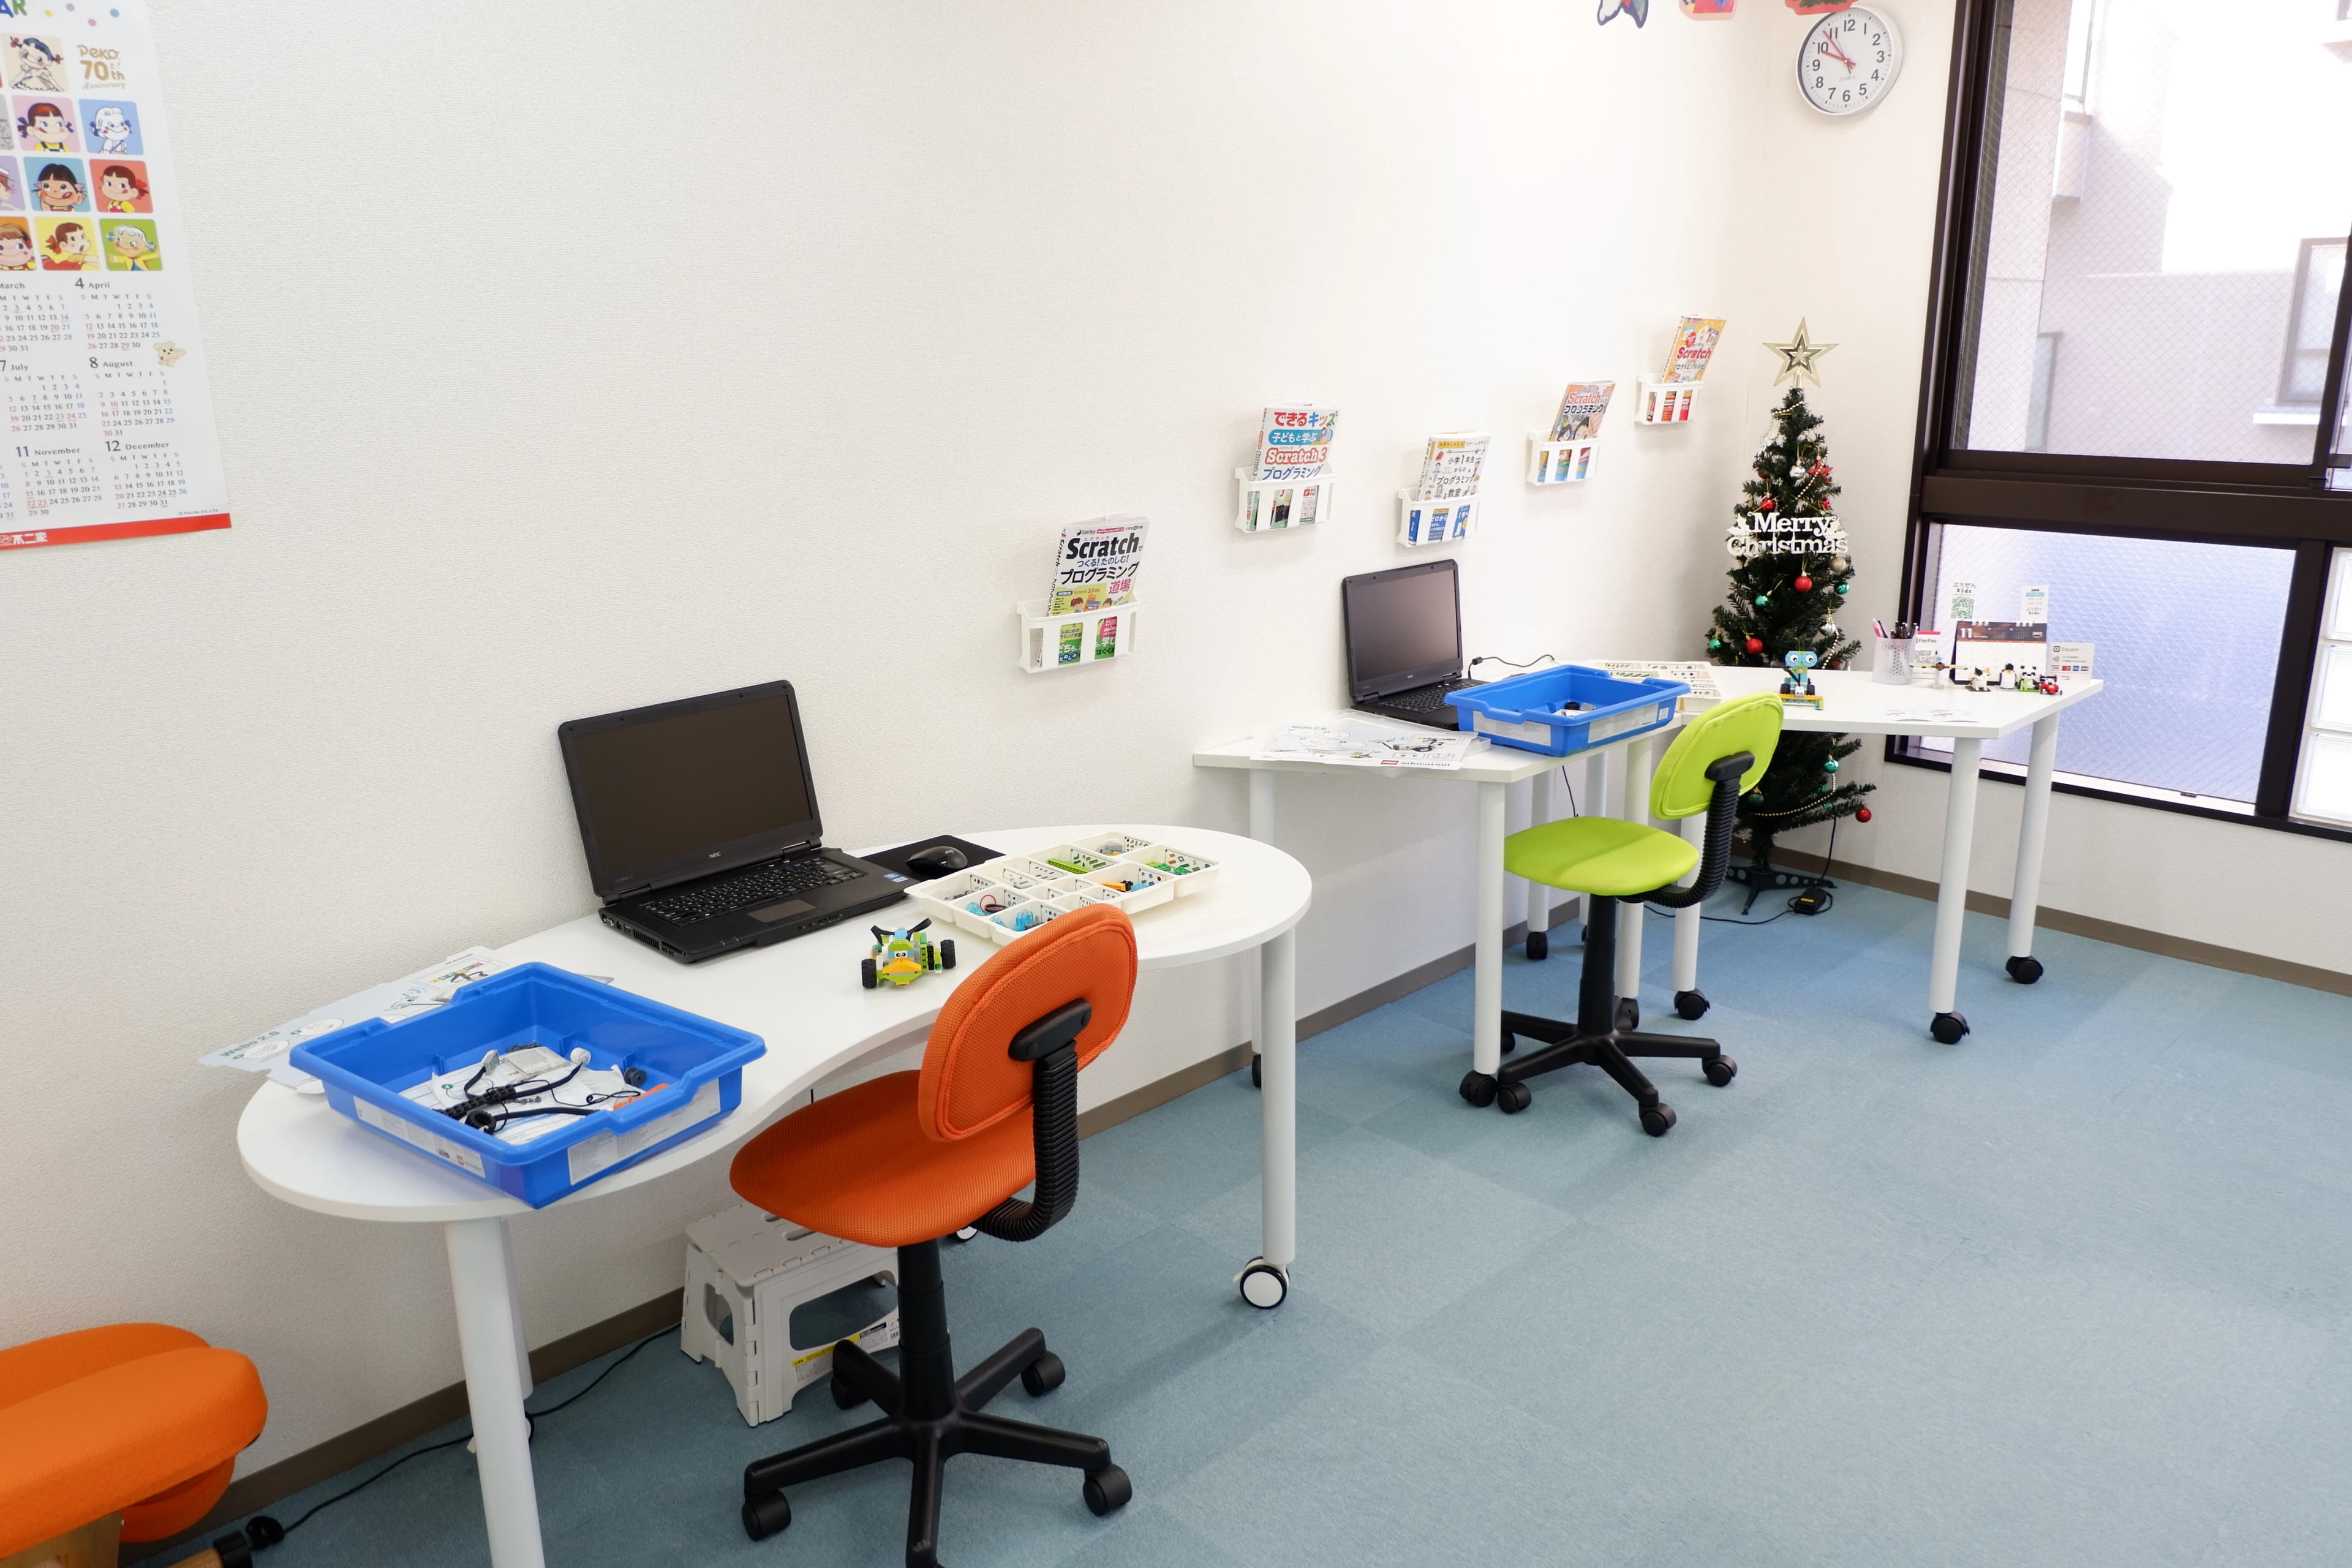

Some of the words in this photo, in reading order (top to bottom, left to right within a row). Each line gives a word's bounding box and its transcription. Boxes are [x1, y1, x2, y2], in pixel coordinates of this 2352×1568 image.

[1844, 19, 1855, 32] 12
[1864, 23, 1866, 34] 1
[1830, 27, 1838, 39] 11
[1872, 34, 1880, 46] 2
[77, 45, 119, 59] Peko
[1818, 42, 1828, 54] 10
[1877, 51, 1884, 62] 3
[80, 60, 109, 81] 70
[1813, 59, 1820, 71] 9
[1871, 69, 1879, 81] 4
[1815, 77, 1823, 88] 8
[1828, 88, 1836, 99] 7
[1859, 83, 1866, 95] 5
[1843, 90, 1850, 102] 6
[75, 277, 85, 288] 4
[1676, 346, 1712, 360] Scratch
[89, 356, 98, 368] 8
[1567, 392, 1600, 404] Scratch
[1274, 412, 1338, 427] できるキッズ
[1272, 432, 1317, 443] 子どもと学ぶ
[15, 446, 29, 457] 11
[105, 440, 121, 451] 12
[1263, 464, 1324, 480] プログラミング
[1747, 511, 1837, 537] Merry
[12, 532, 48, 545] 不二家
[1727, 532, 1849, 557] Christmas
[1066, 532, 1139, 560] Scratch
[1061, 561, 1140, 585] プログラミング
[1109, 579, 1131, 595] 道場
[1960, 628, 1972, 638] 11
